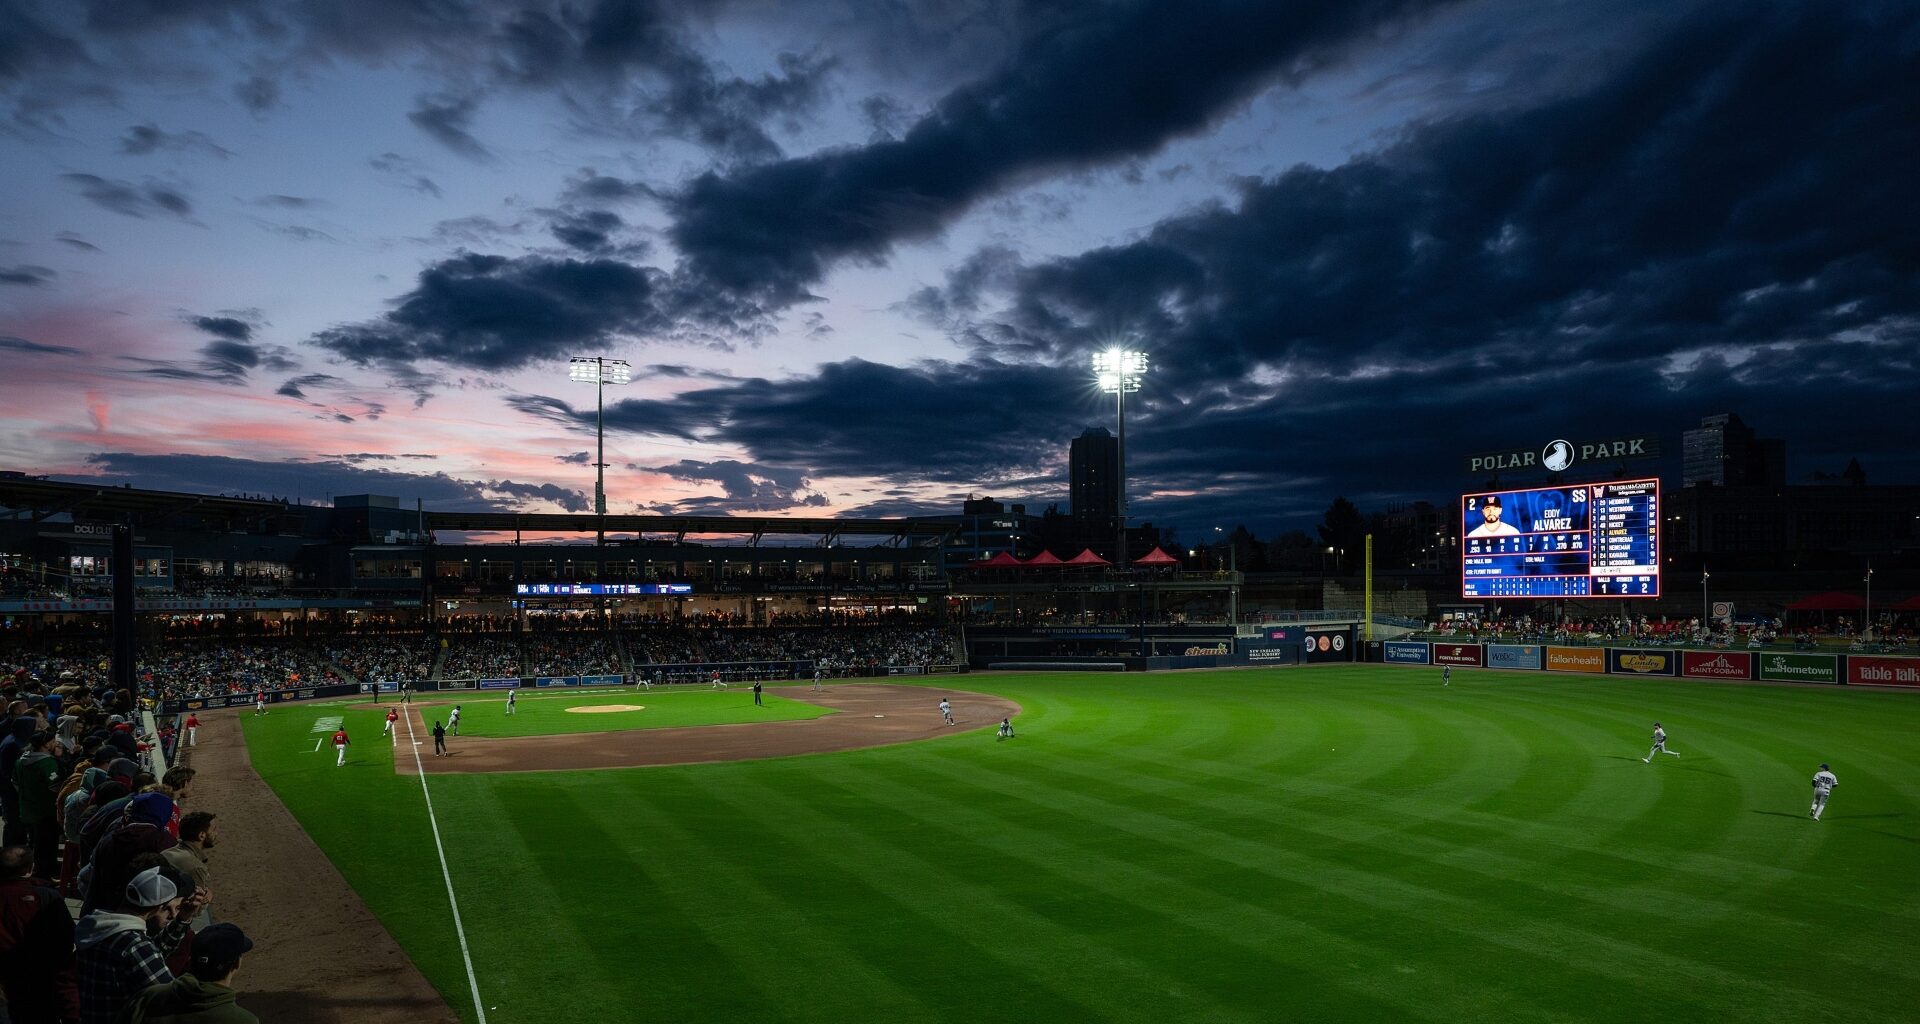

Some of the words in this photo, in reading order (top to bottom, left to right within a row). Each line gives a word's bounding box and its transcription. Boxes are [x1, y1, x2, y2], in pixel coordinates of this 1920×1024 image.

[1471, 452, 1536, 472] POLAR
[1581, 439, 1646, 460] PARK
[1572, 490, 1585, 502] SS
[1469, 499, 1475, 510] 2
[1544, 509, 1560, 518] EDDY
[74, 525, 94, 533] DCU
[1533, 518, 1571, 530] ALVAREZ
[1602, 584, 1606, 593] 1
[1622, 583, 1627, 593] 2
[1642, 583, 1647, 593] 2
[1397, 646, 1426, 654] Assumption
[1397, 652, 1421, 660] University
[1550, 653, 1601, 665] fallonhealth
[1690, 666, 1743, 675] SAINT-GOBAIN
[1858, 666, 1892, 681] Table
[1896, 667, 1920, 682] Talk
